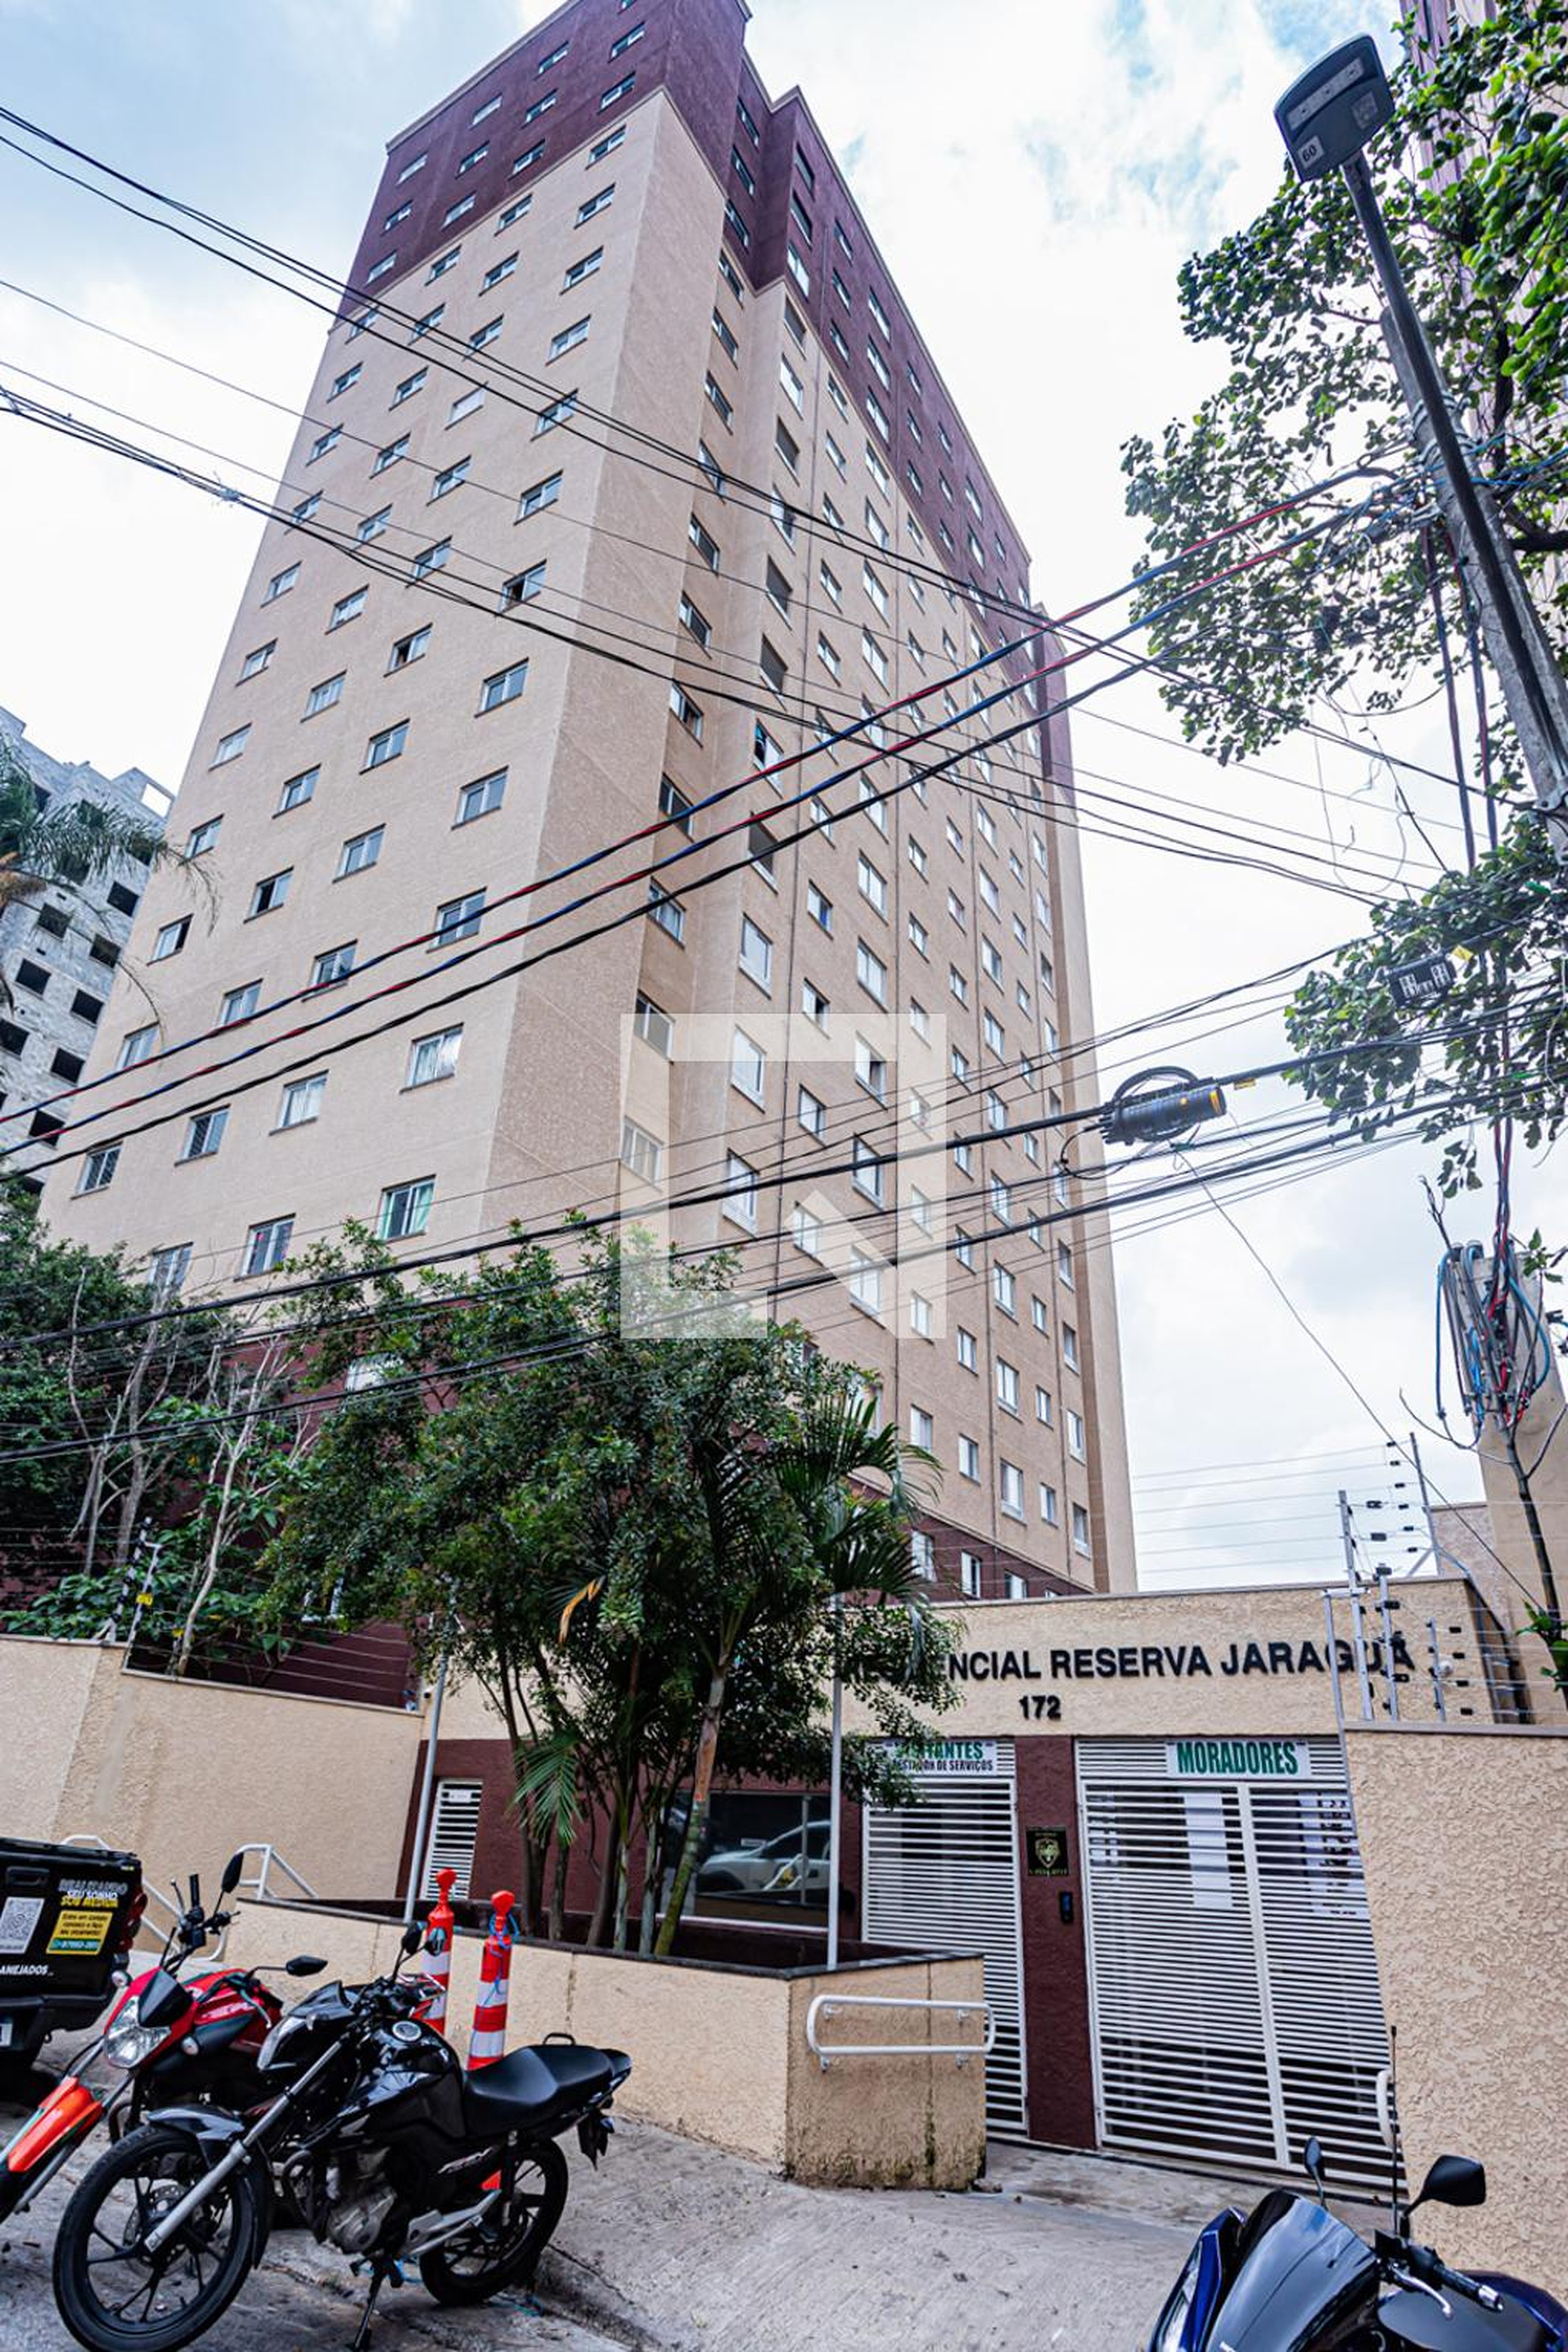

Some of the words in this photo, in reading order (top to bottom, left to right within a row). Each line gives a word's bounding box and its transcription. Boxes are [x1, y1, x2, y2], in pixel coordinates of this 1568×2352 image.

[1302, 144, 1317, 162] 60
[1050, 1645, 1212, 1679] RESERVA
[1019, 1695, 1062, 1720] 172
[1176, 1741, 1298, 1775] MORADORES
